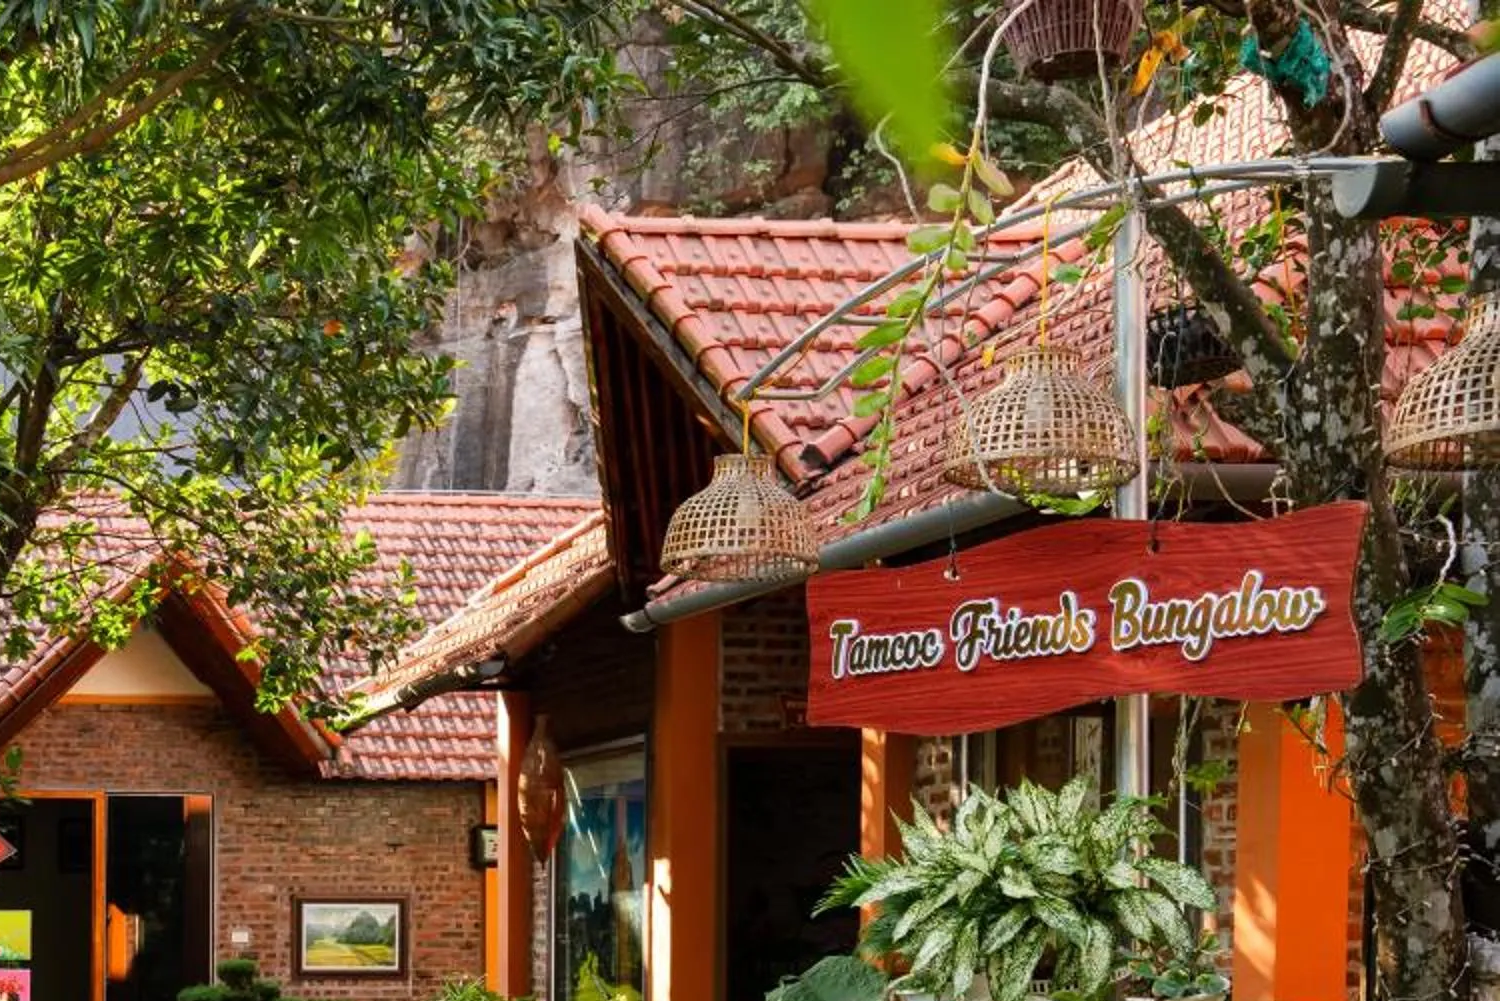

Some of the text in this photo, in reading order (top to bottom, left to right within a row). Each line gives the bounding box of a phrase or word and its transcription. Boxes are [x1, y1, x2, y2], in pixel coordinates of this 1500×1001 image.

[830, 570, 1325, 678] Tamcoc Friends Bungalow
